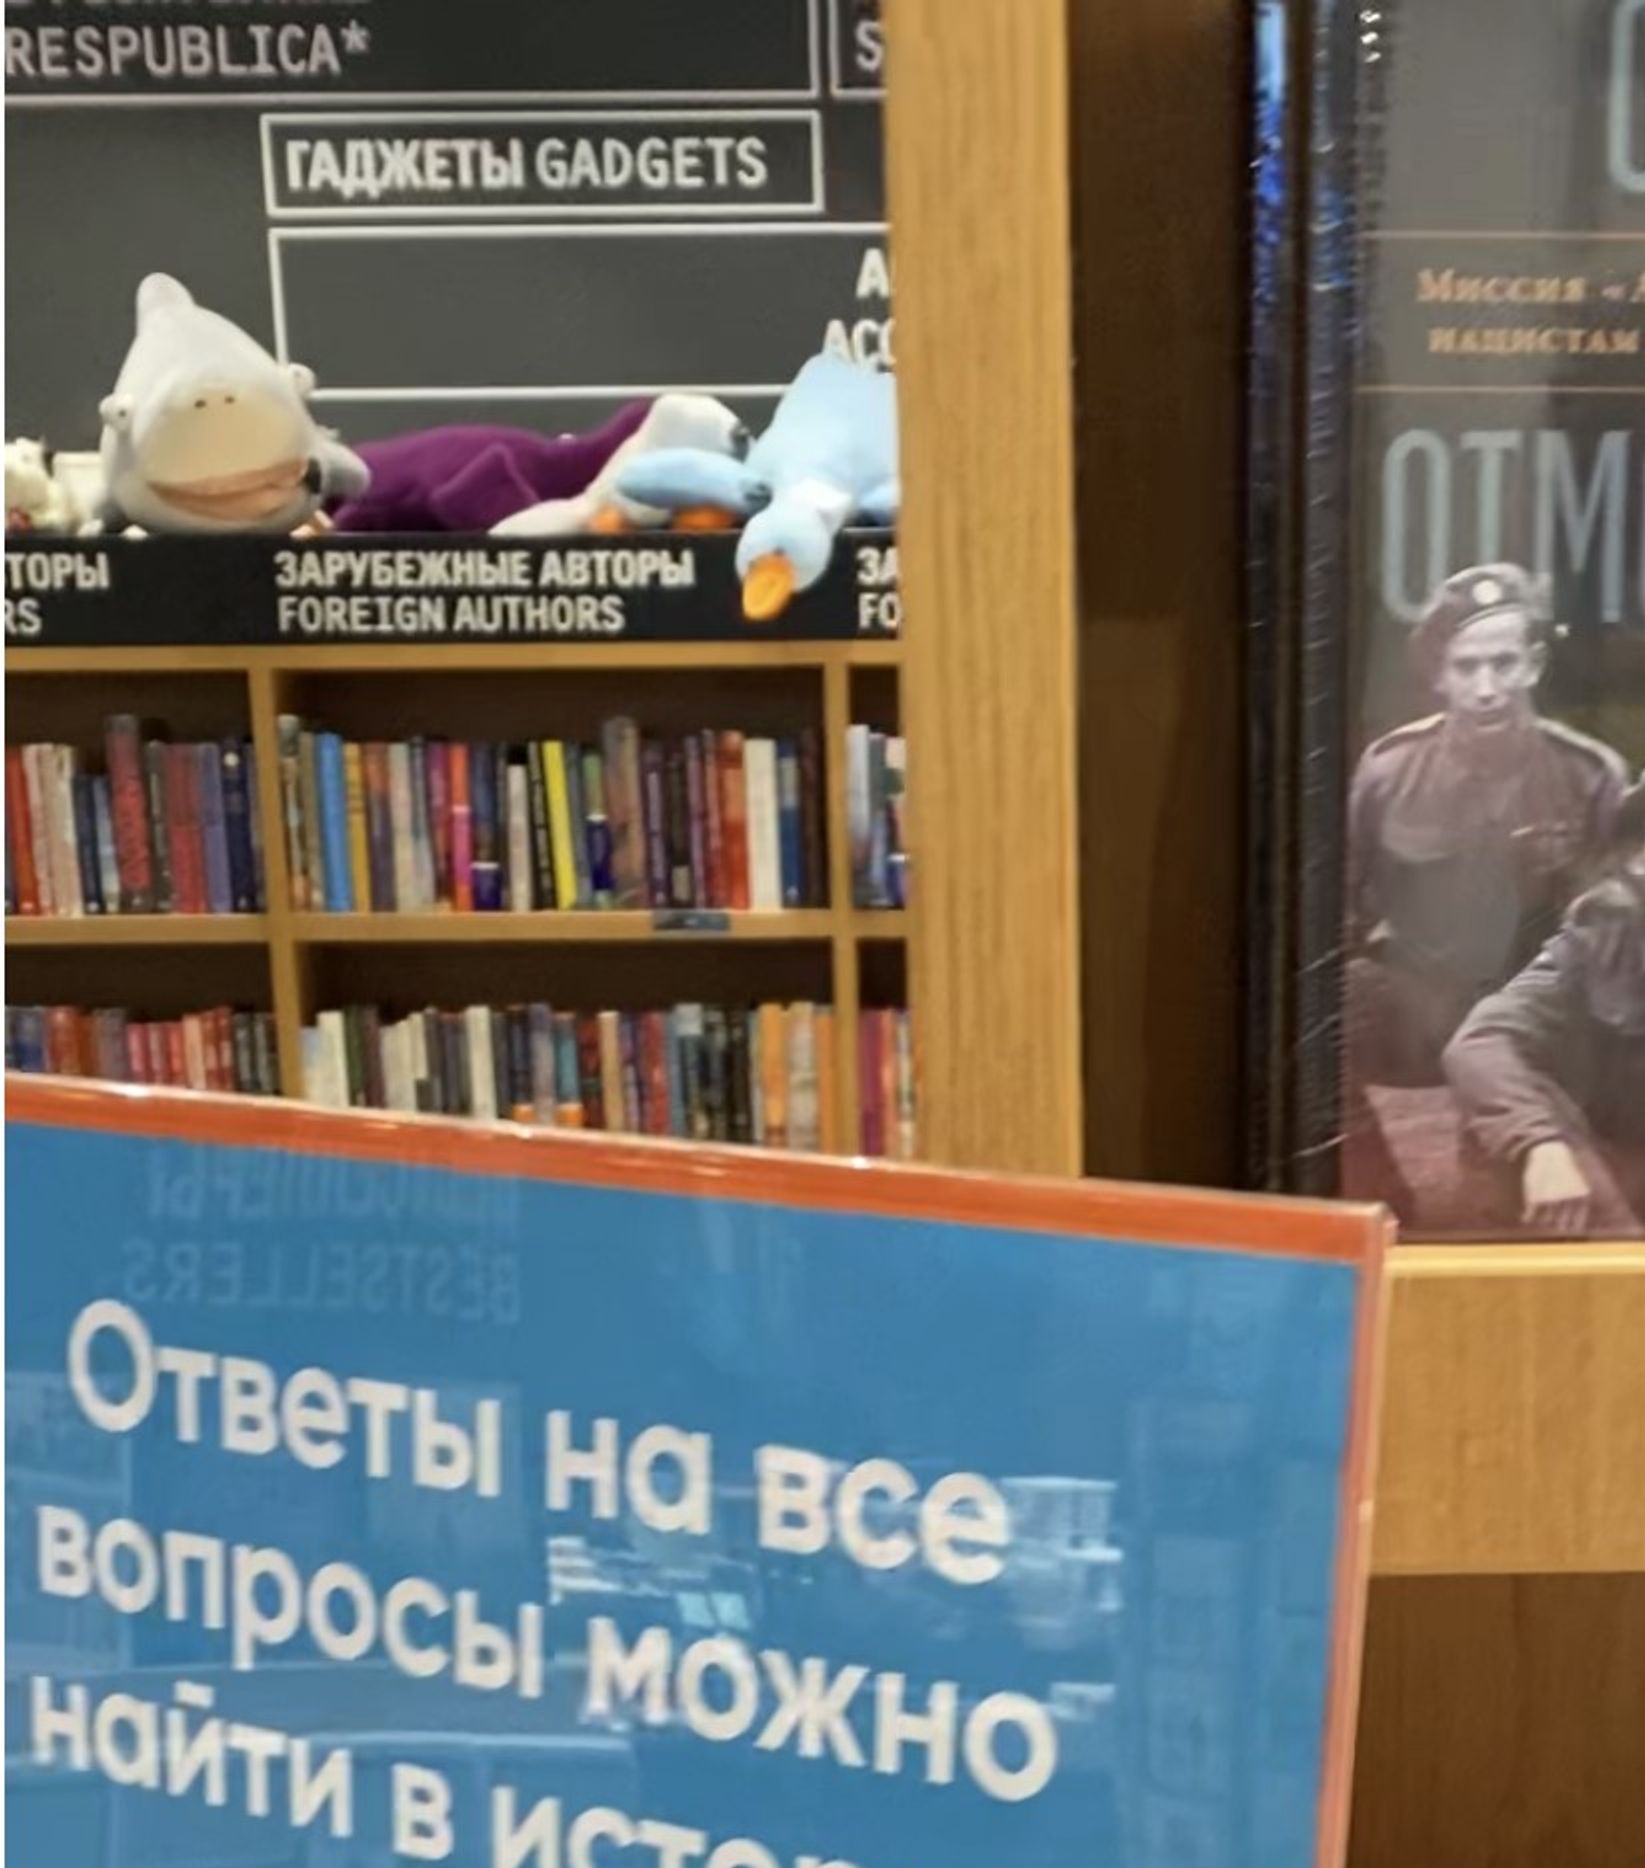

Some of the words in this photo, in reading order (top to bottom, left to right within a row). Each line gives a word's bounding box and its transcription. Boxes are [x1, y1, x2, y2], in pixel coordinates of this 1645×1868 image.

[286, 138, 525, 196] ГАДЖЕТЫ
[536, 137, 768, 188] GADGETS
[275, 549, 532, 591] ЗАРУБЕЖНЫЕ
[540, 549, 695, 588] АВТОРЫ
[279, 596, 447, 634] FOREIGN
[454, 595, 627, 633] AUTHORS
[67, 1298, 502, 1498] Ответы
[544, 1409, 713, 1538] на
[756, 1444, 1004, 1588] все
[37, 1504, 546, 1699] вопросы
[585, 1614, 1061, 1803] можно
[29, 1675, 352, 1839] найти
[391, 1762, 453, 1861] в
